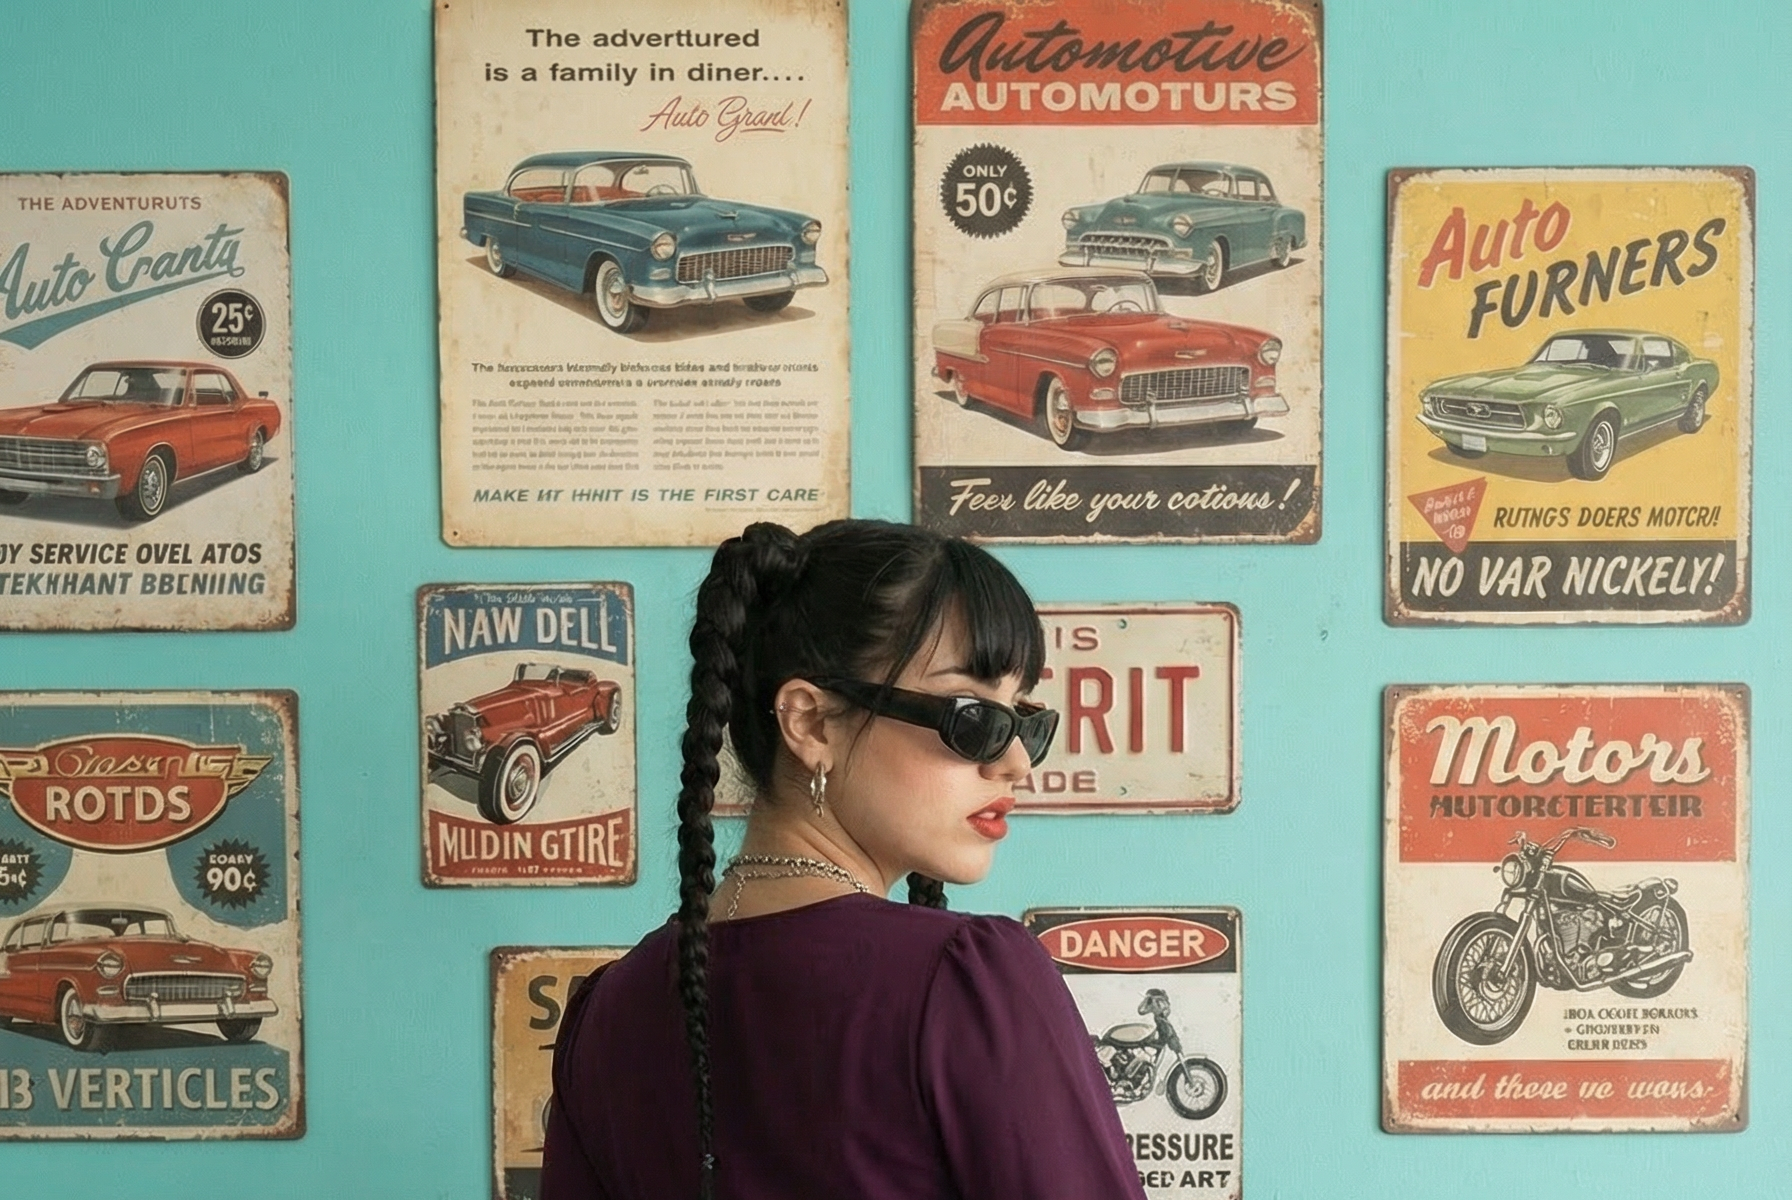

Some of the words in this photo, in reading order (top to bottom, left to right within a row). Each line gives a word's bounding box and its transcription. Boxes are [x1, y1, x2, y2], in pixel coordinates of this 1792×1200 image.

[525, 29, 580, 47] The
[938, 11, 1305, 82] Automotive
[485, 63, 508, 81] is
[521, 67, 538, 81] a
[550, 63, 638, 86] family
[650, 63, 674, 81] in
[940, 81, 1297, 112] AUTOMOTURS
[963, 165, 1007, 177] ONLY
[18, 198, 54, 210] THE
[956, 181, 1017, 217] 50¢
[1417, 198, 1571, 288] Auto
[1467, 218, 1726, 339] FURNERS
[211, 302, 254, 333] 25¢
[473, 489, 529, 502] MAKE
[631, 489, 649, 502] IS
[659, 489, 696, 502] THE
[704, 489, 759, 502] FIRST
[766, 489, 819, 502] CARE
[1023, 479, 1083, 511] like
[1085, 488, 1162, 522] your
[1577, 506, 1641, 528] DOERS
[29, 543, 129, 565] SERVICE
[136, 543, 193, 564] OVEL
[201, 543, 263, 564] ATOS
[1412, 555, 1465, 598] NO
[1478, 555, 1552, 599] VAR
[1562, 553, 1725, 597] NICKELY!
[444, 605, 522, 655] NAW
[536, 600, 617, 653] DELL
[1041, 665, 1200, 754] RIT
[1426, 715, 1711, 786] Motors
[46, 785, 192, 821] ROTDS
[206, 866, 257, 892] 90¢
[1060, 929, 1206, 958] DANGER
[47, 1067, 280, 1110] VERTICLES
[1421, 1073, 1486, 1100] and
[1179, 1170, 1231, 1188] ART
